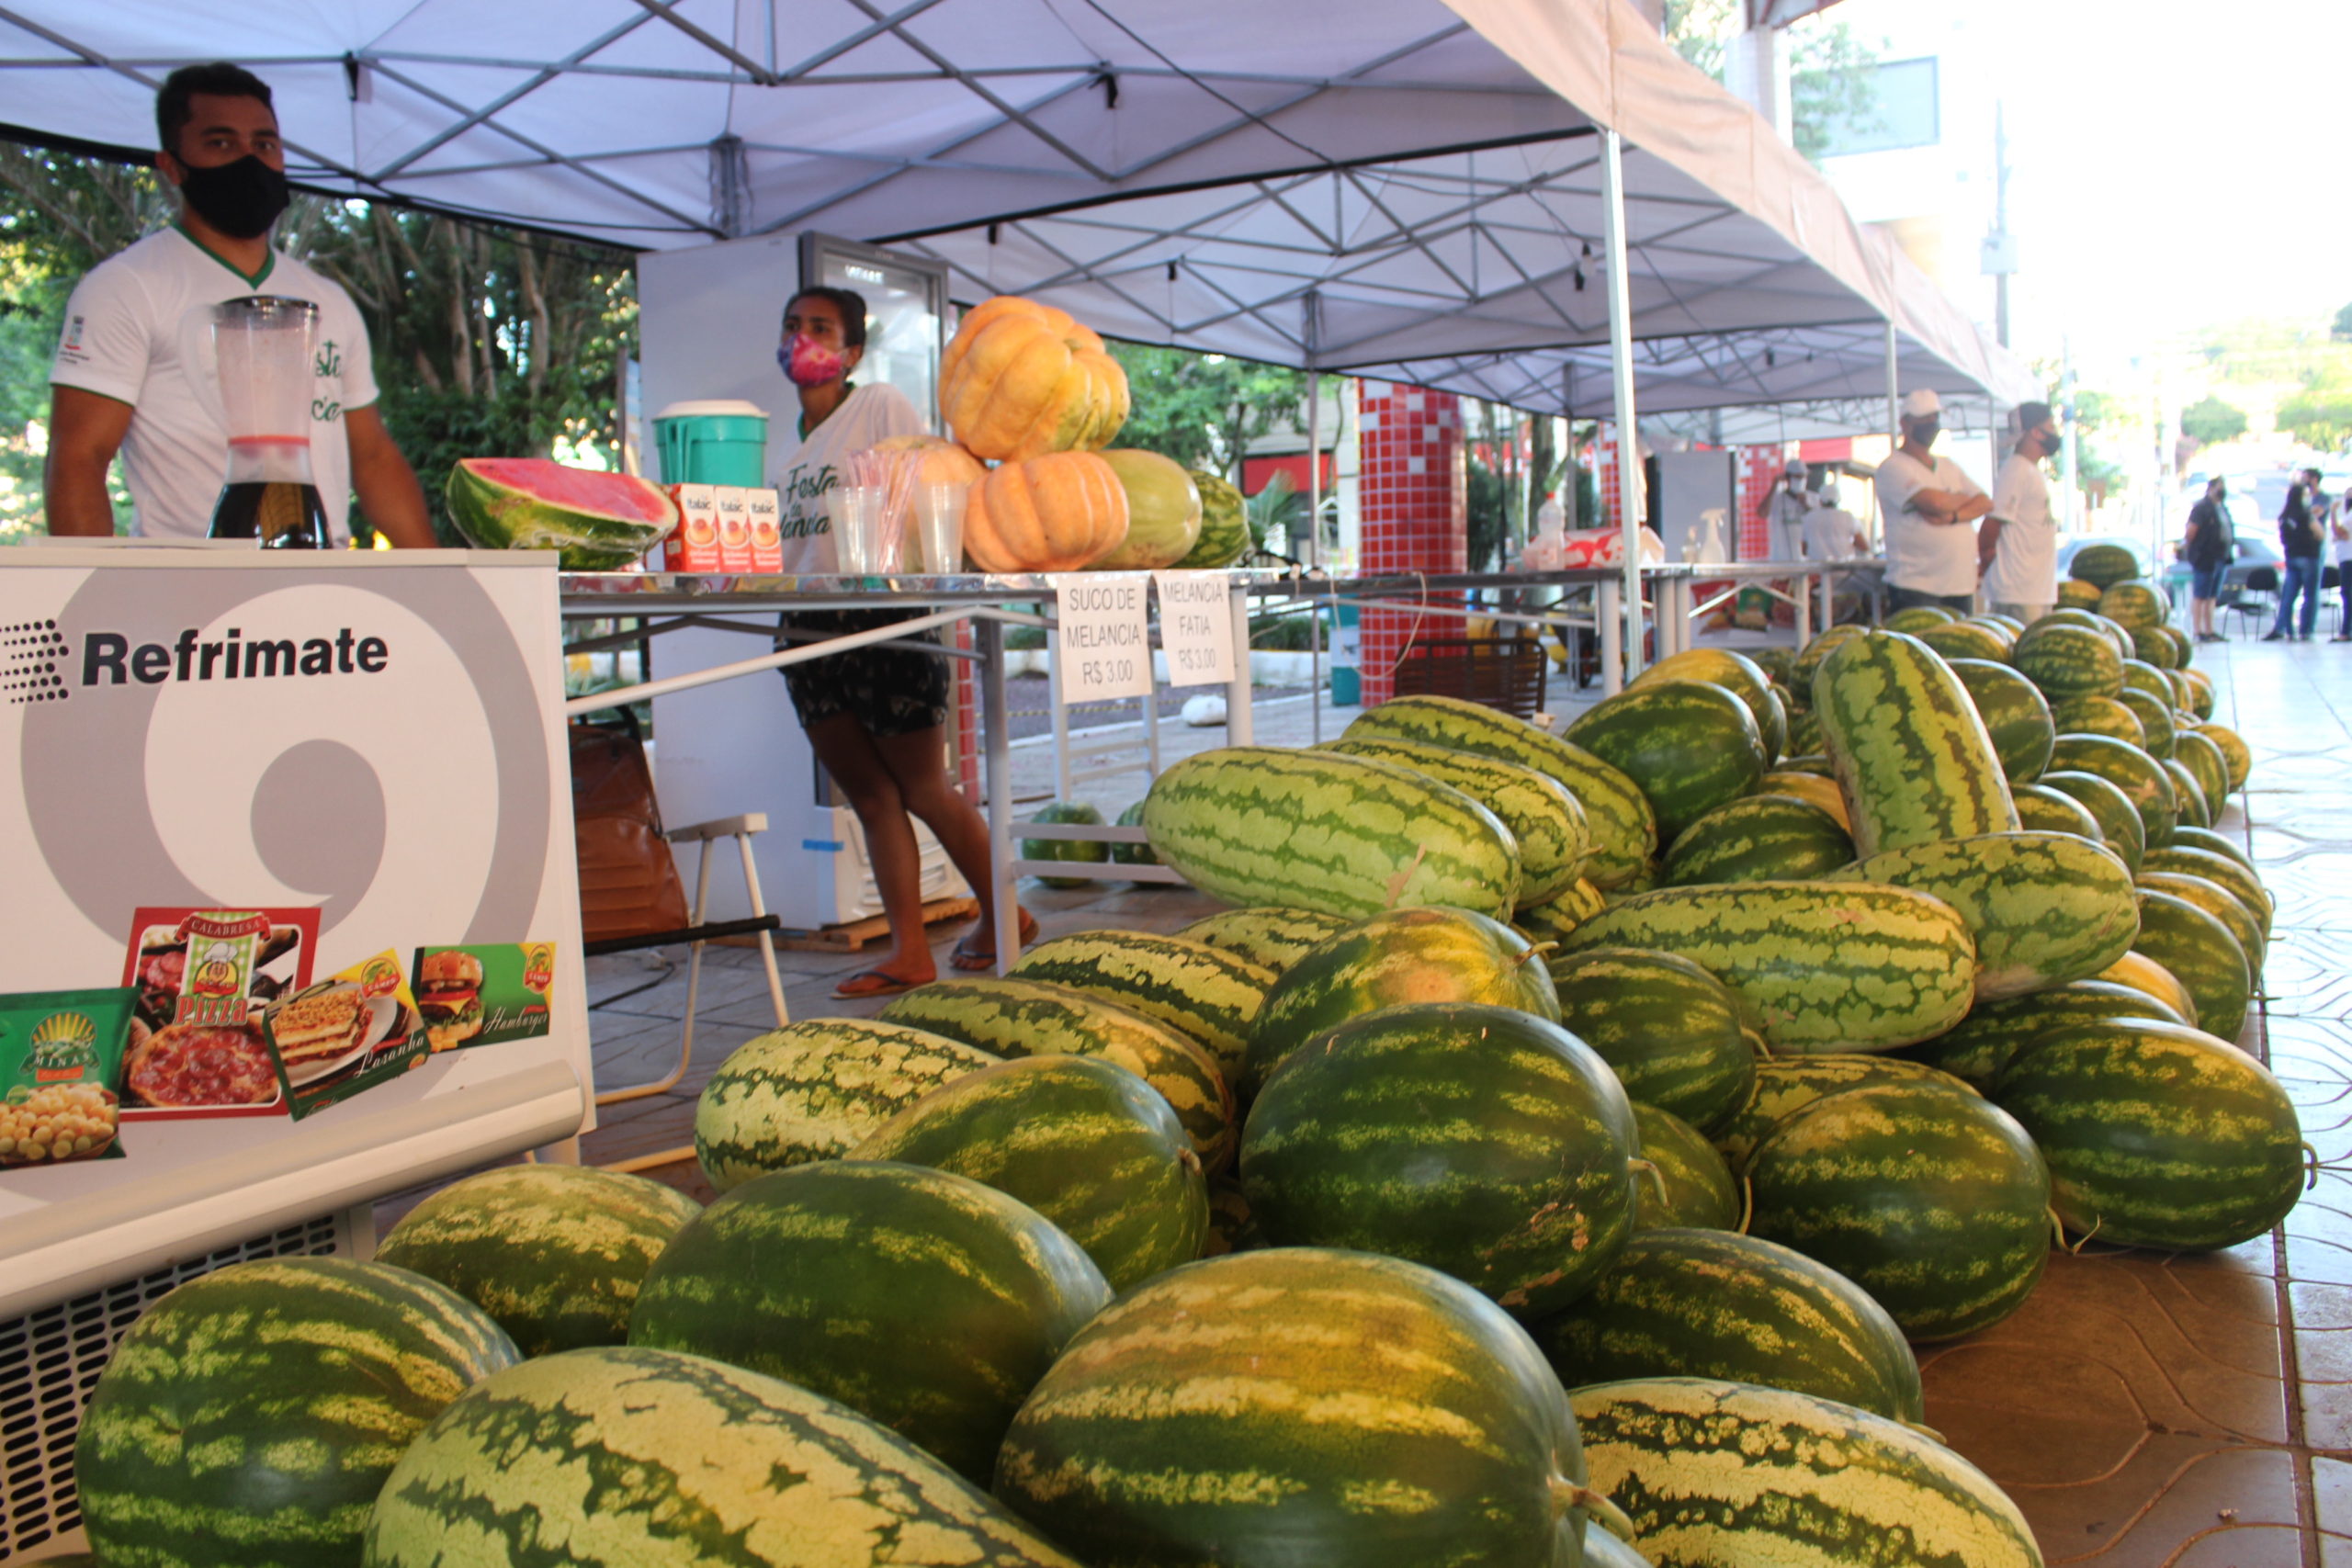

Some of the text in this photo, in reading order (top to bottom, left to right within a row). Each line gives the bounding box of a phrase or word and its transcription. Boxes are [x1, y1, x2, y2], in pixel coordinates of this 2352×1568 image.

[1069, 588, 1136, 612] SUCO DE
[1163, 581, 1224, 603] MELANCIA
[1067, 625, 1142, 649] MELANCIA
[1180, 616, 1212, 637] FATIA
[82, 627, 389, 686] Refrimate
[1083, 663, 1102, 684] R$
[190, 918, 261, 936] CALABRESA
[174, 995, 249, 1026] Pizza
[483, 1006, 548, 1035] Hamburger
[33, 1053, 90, 1068] MINAS
[353, 1030, 424, 1078] Lasanha
